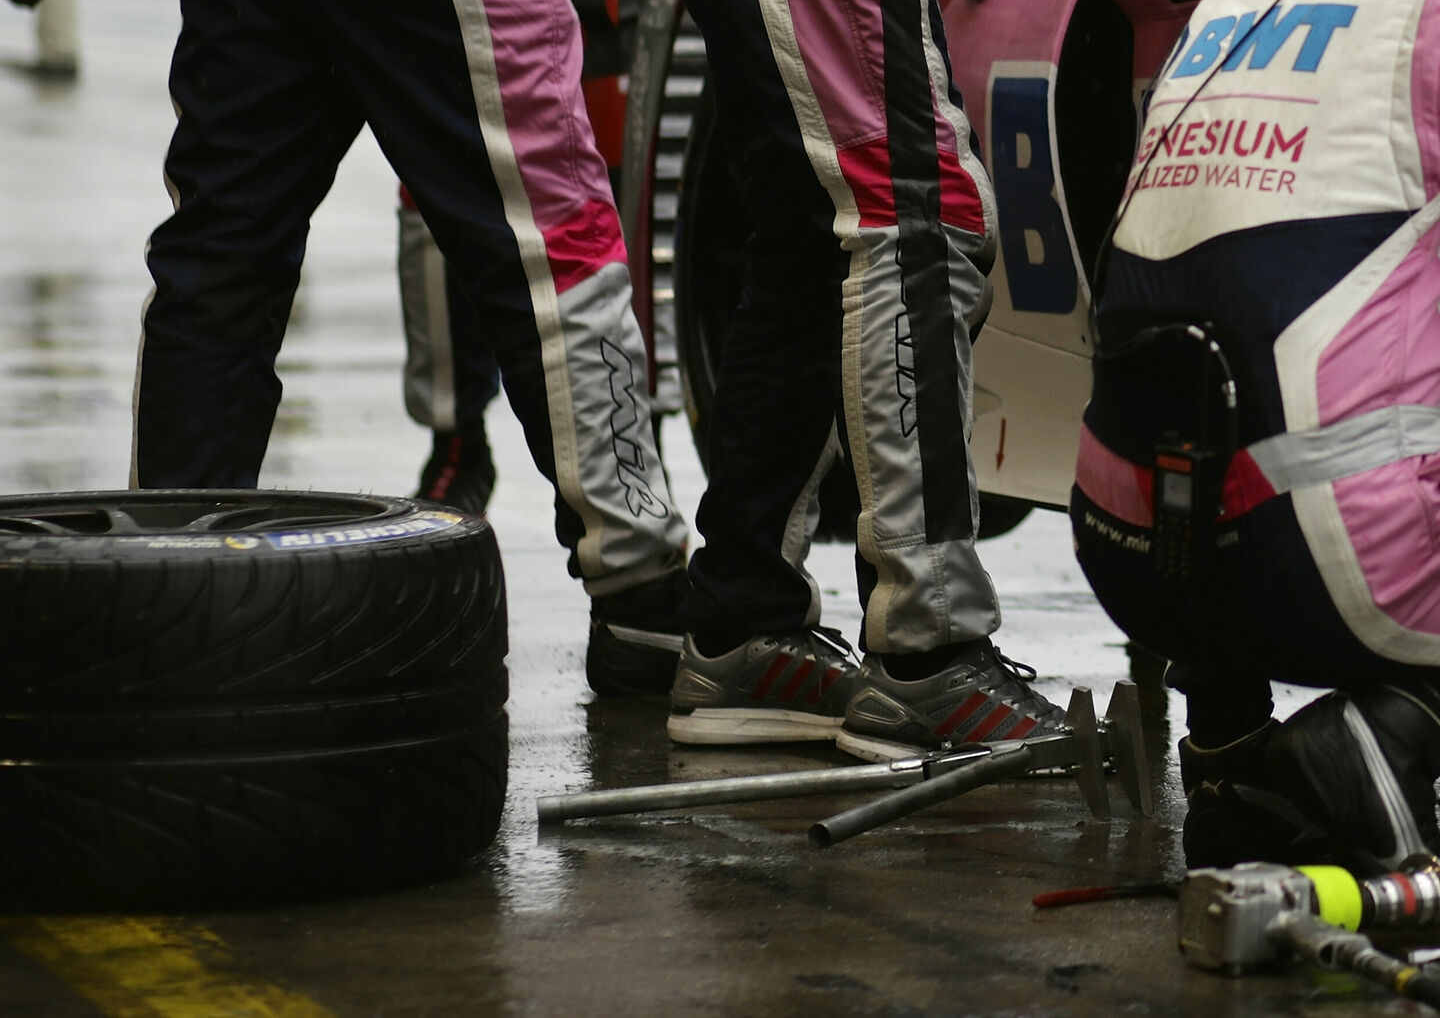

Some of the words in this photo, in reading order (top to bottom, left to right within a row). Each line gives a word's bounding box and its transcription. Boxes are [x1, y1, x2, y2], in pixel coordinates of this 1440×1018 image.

[1169, 3, 1358, 79] BWT
[1204, 164, 1297, 194] WATER
[279, 517, 436, 548] MICHELIN
